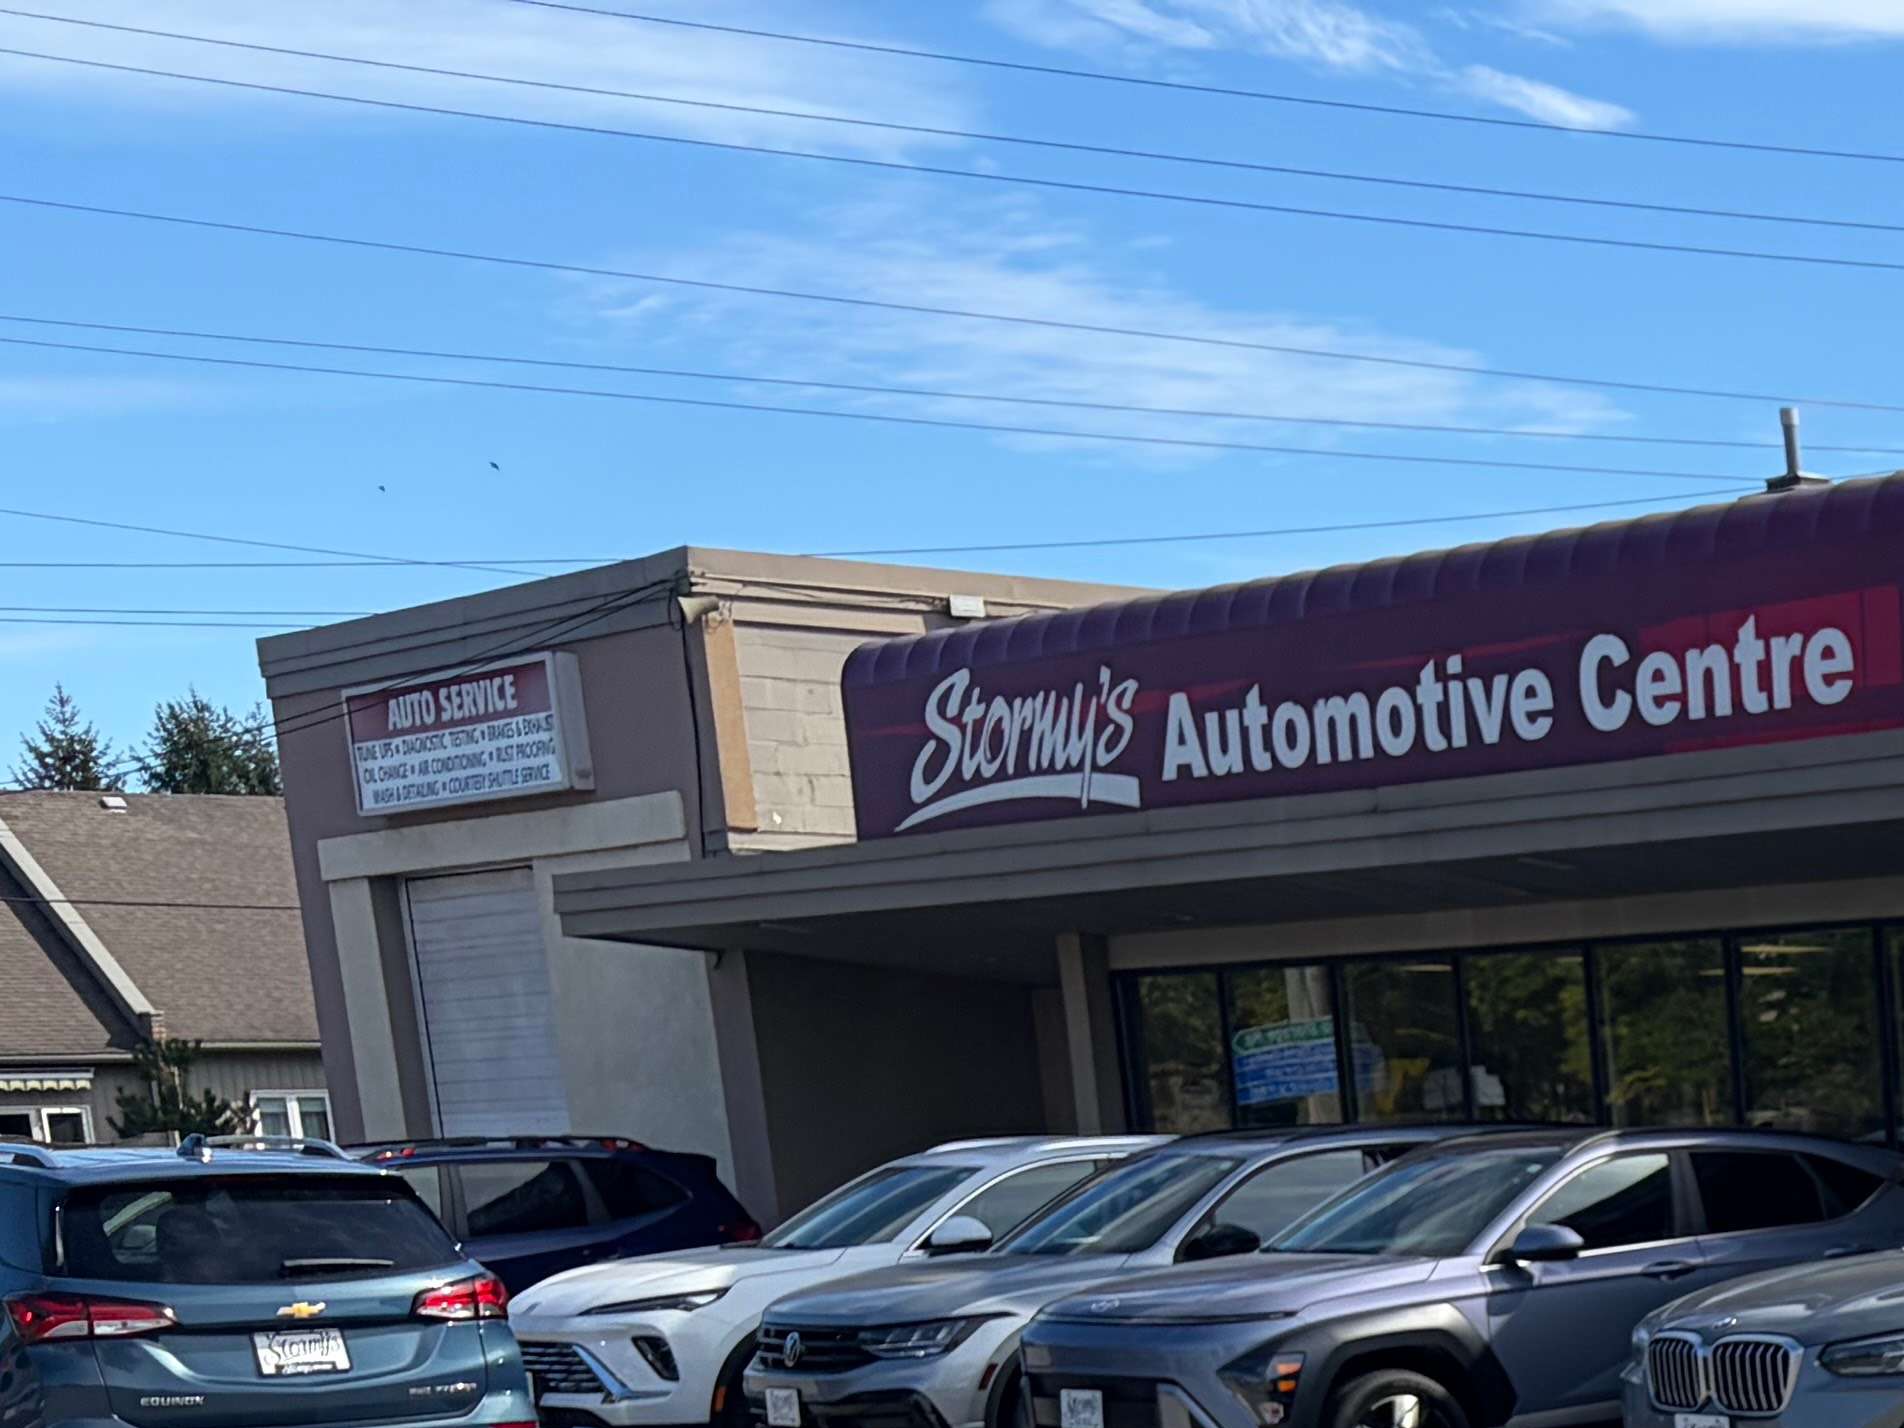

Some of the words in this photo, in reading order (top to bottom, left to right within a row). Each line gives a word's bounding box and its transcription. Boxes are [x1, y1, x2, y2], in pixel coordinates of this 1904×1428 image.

[388, 690, 435, 730] AUTO
[440, 674, 517, 721] SERVICE
[898, 664, 1141, 818] Stormy's
[1160, 655, 1554, 783] Automotive
[1580, 614, 1856, 732] Centre
[140, 1395, 205, 1407] EQUINOX
